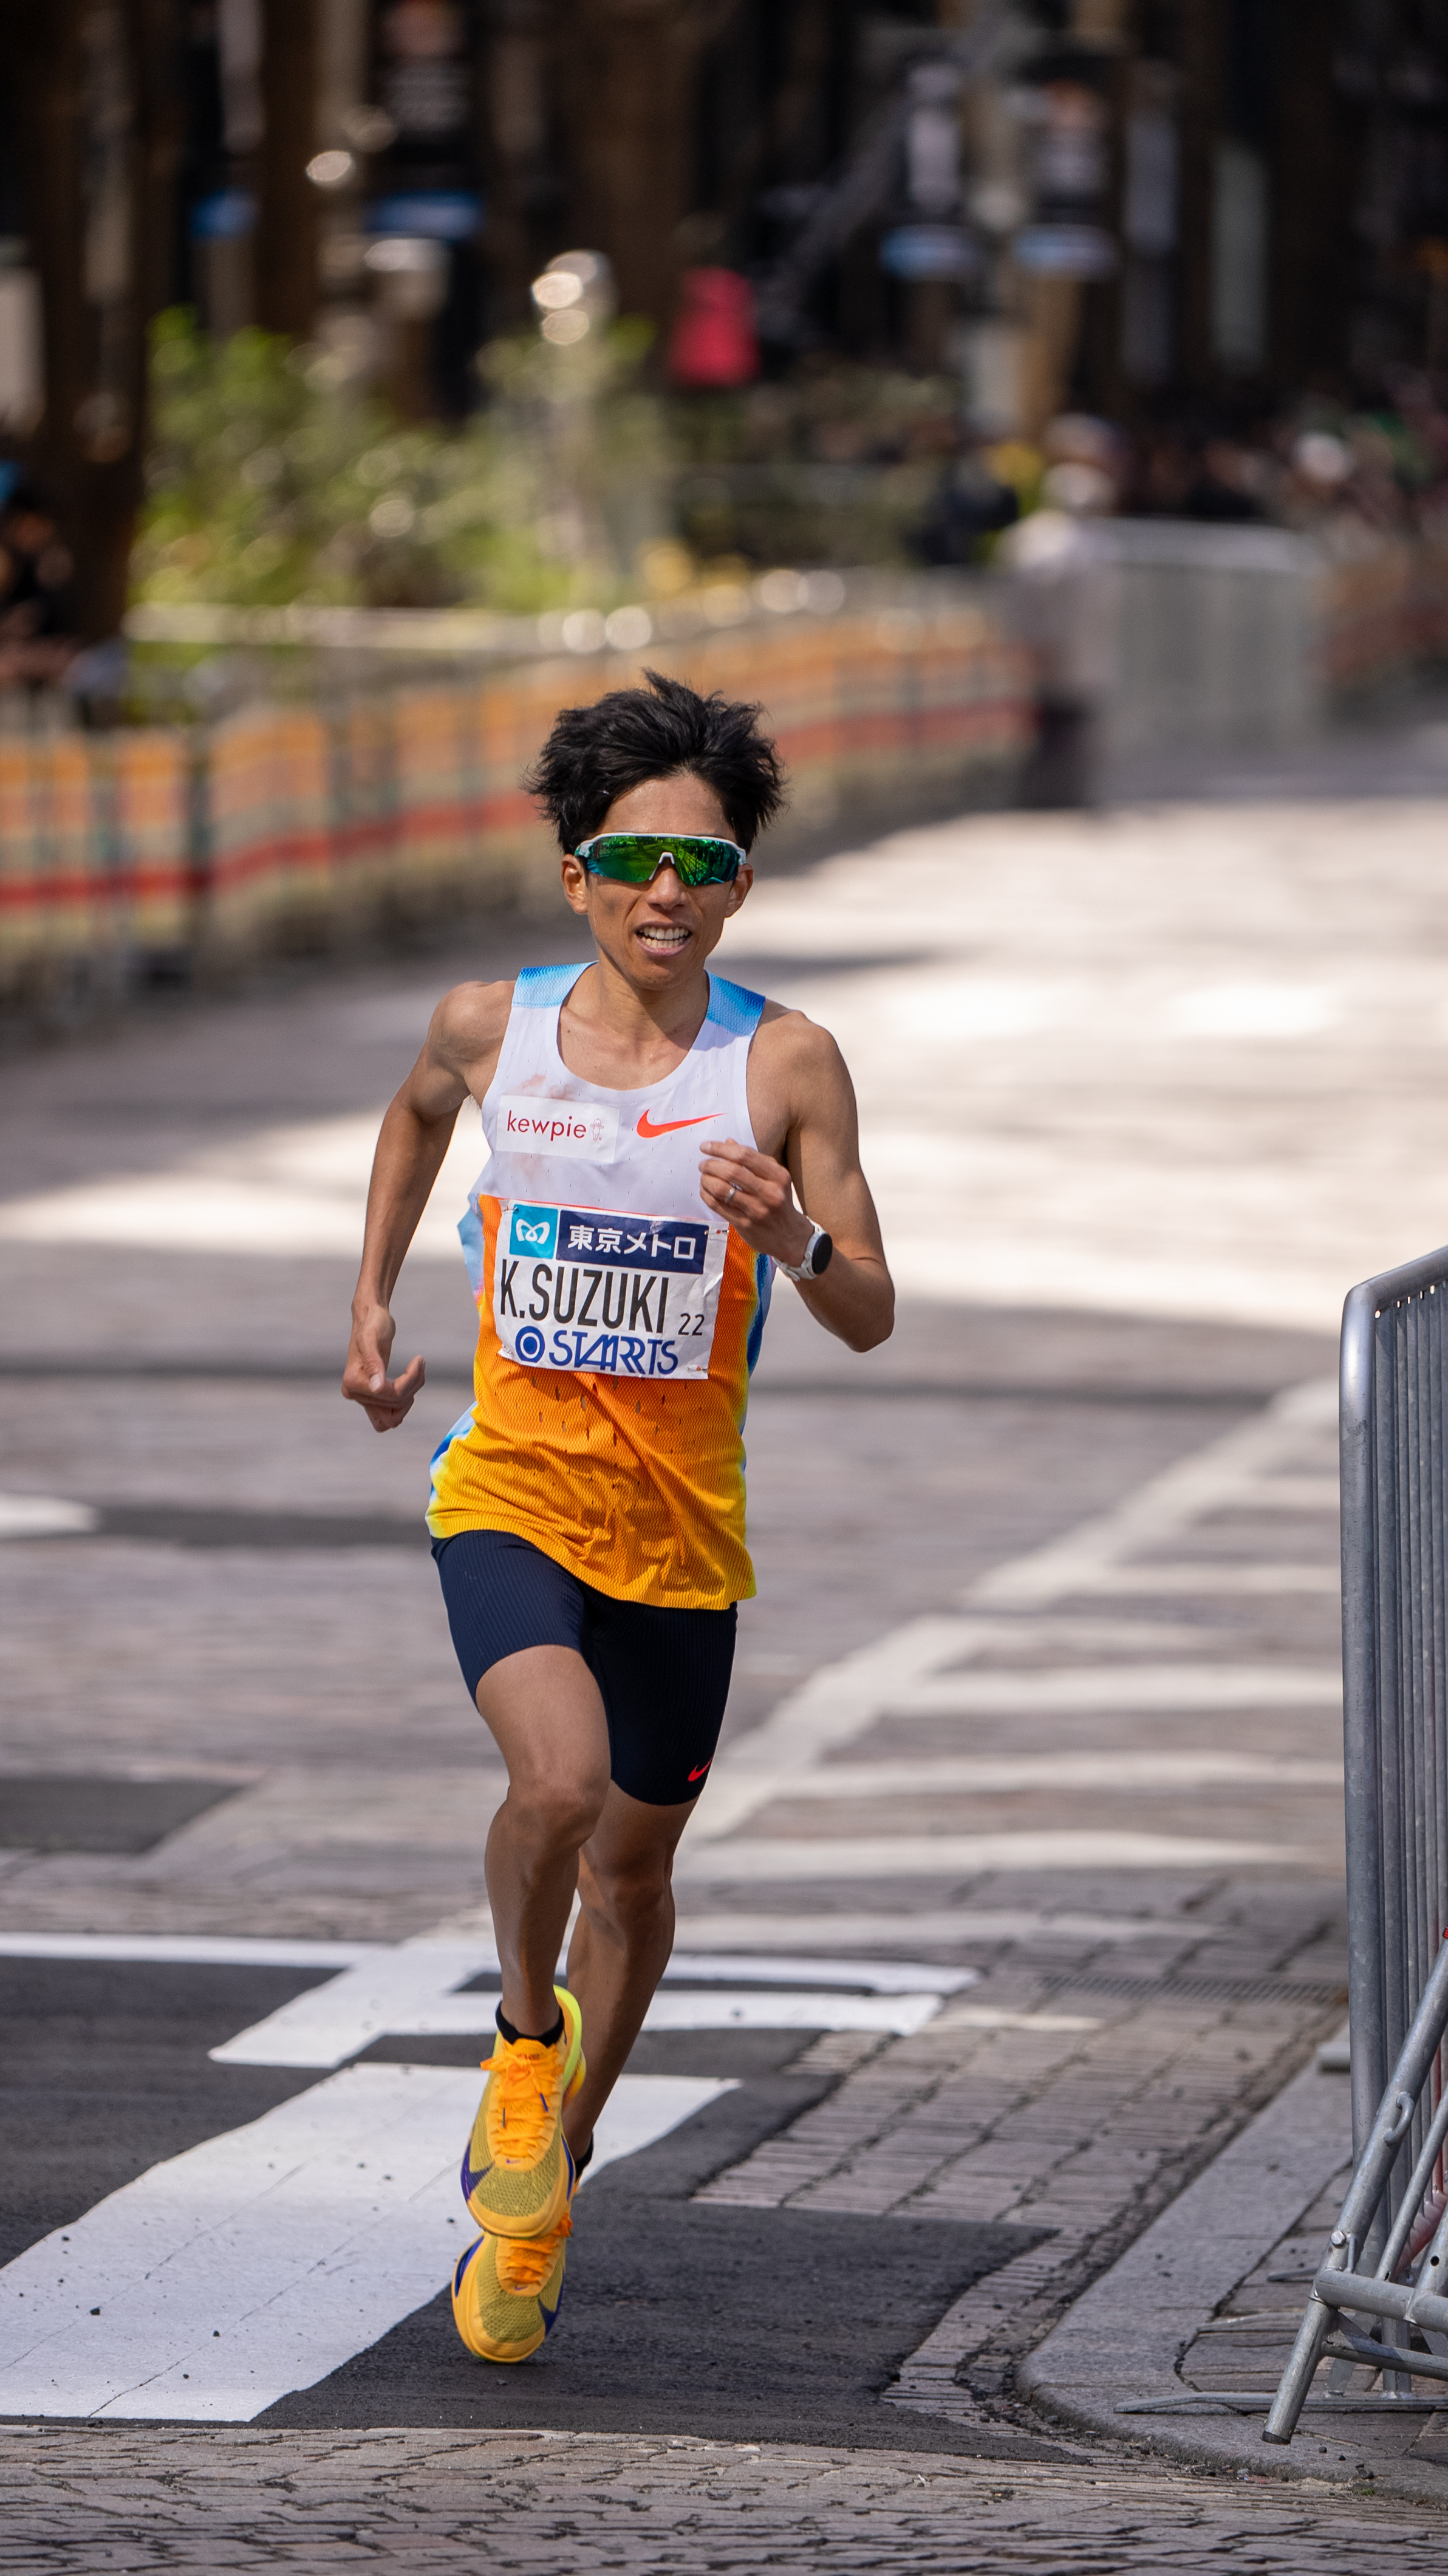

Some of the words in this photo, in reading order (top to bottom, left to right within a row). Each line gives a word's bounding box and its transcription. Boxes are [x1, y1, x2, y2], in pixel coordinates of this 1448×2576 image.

[507, 1110, 587, 1141] kewpie
[568, 1225, 696, 1259] 東京メトロ
[500, 1259, 669, 1334] K.SUZUKI
[677, 1313, 705, 1336] 22
